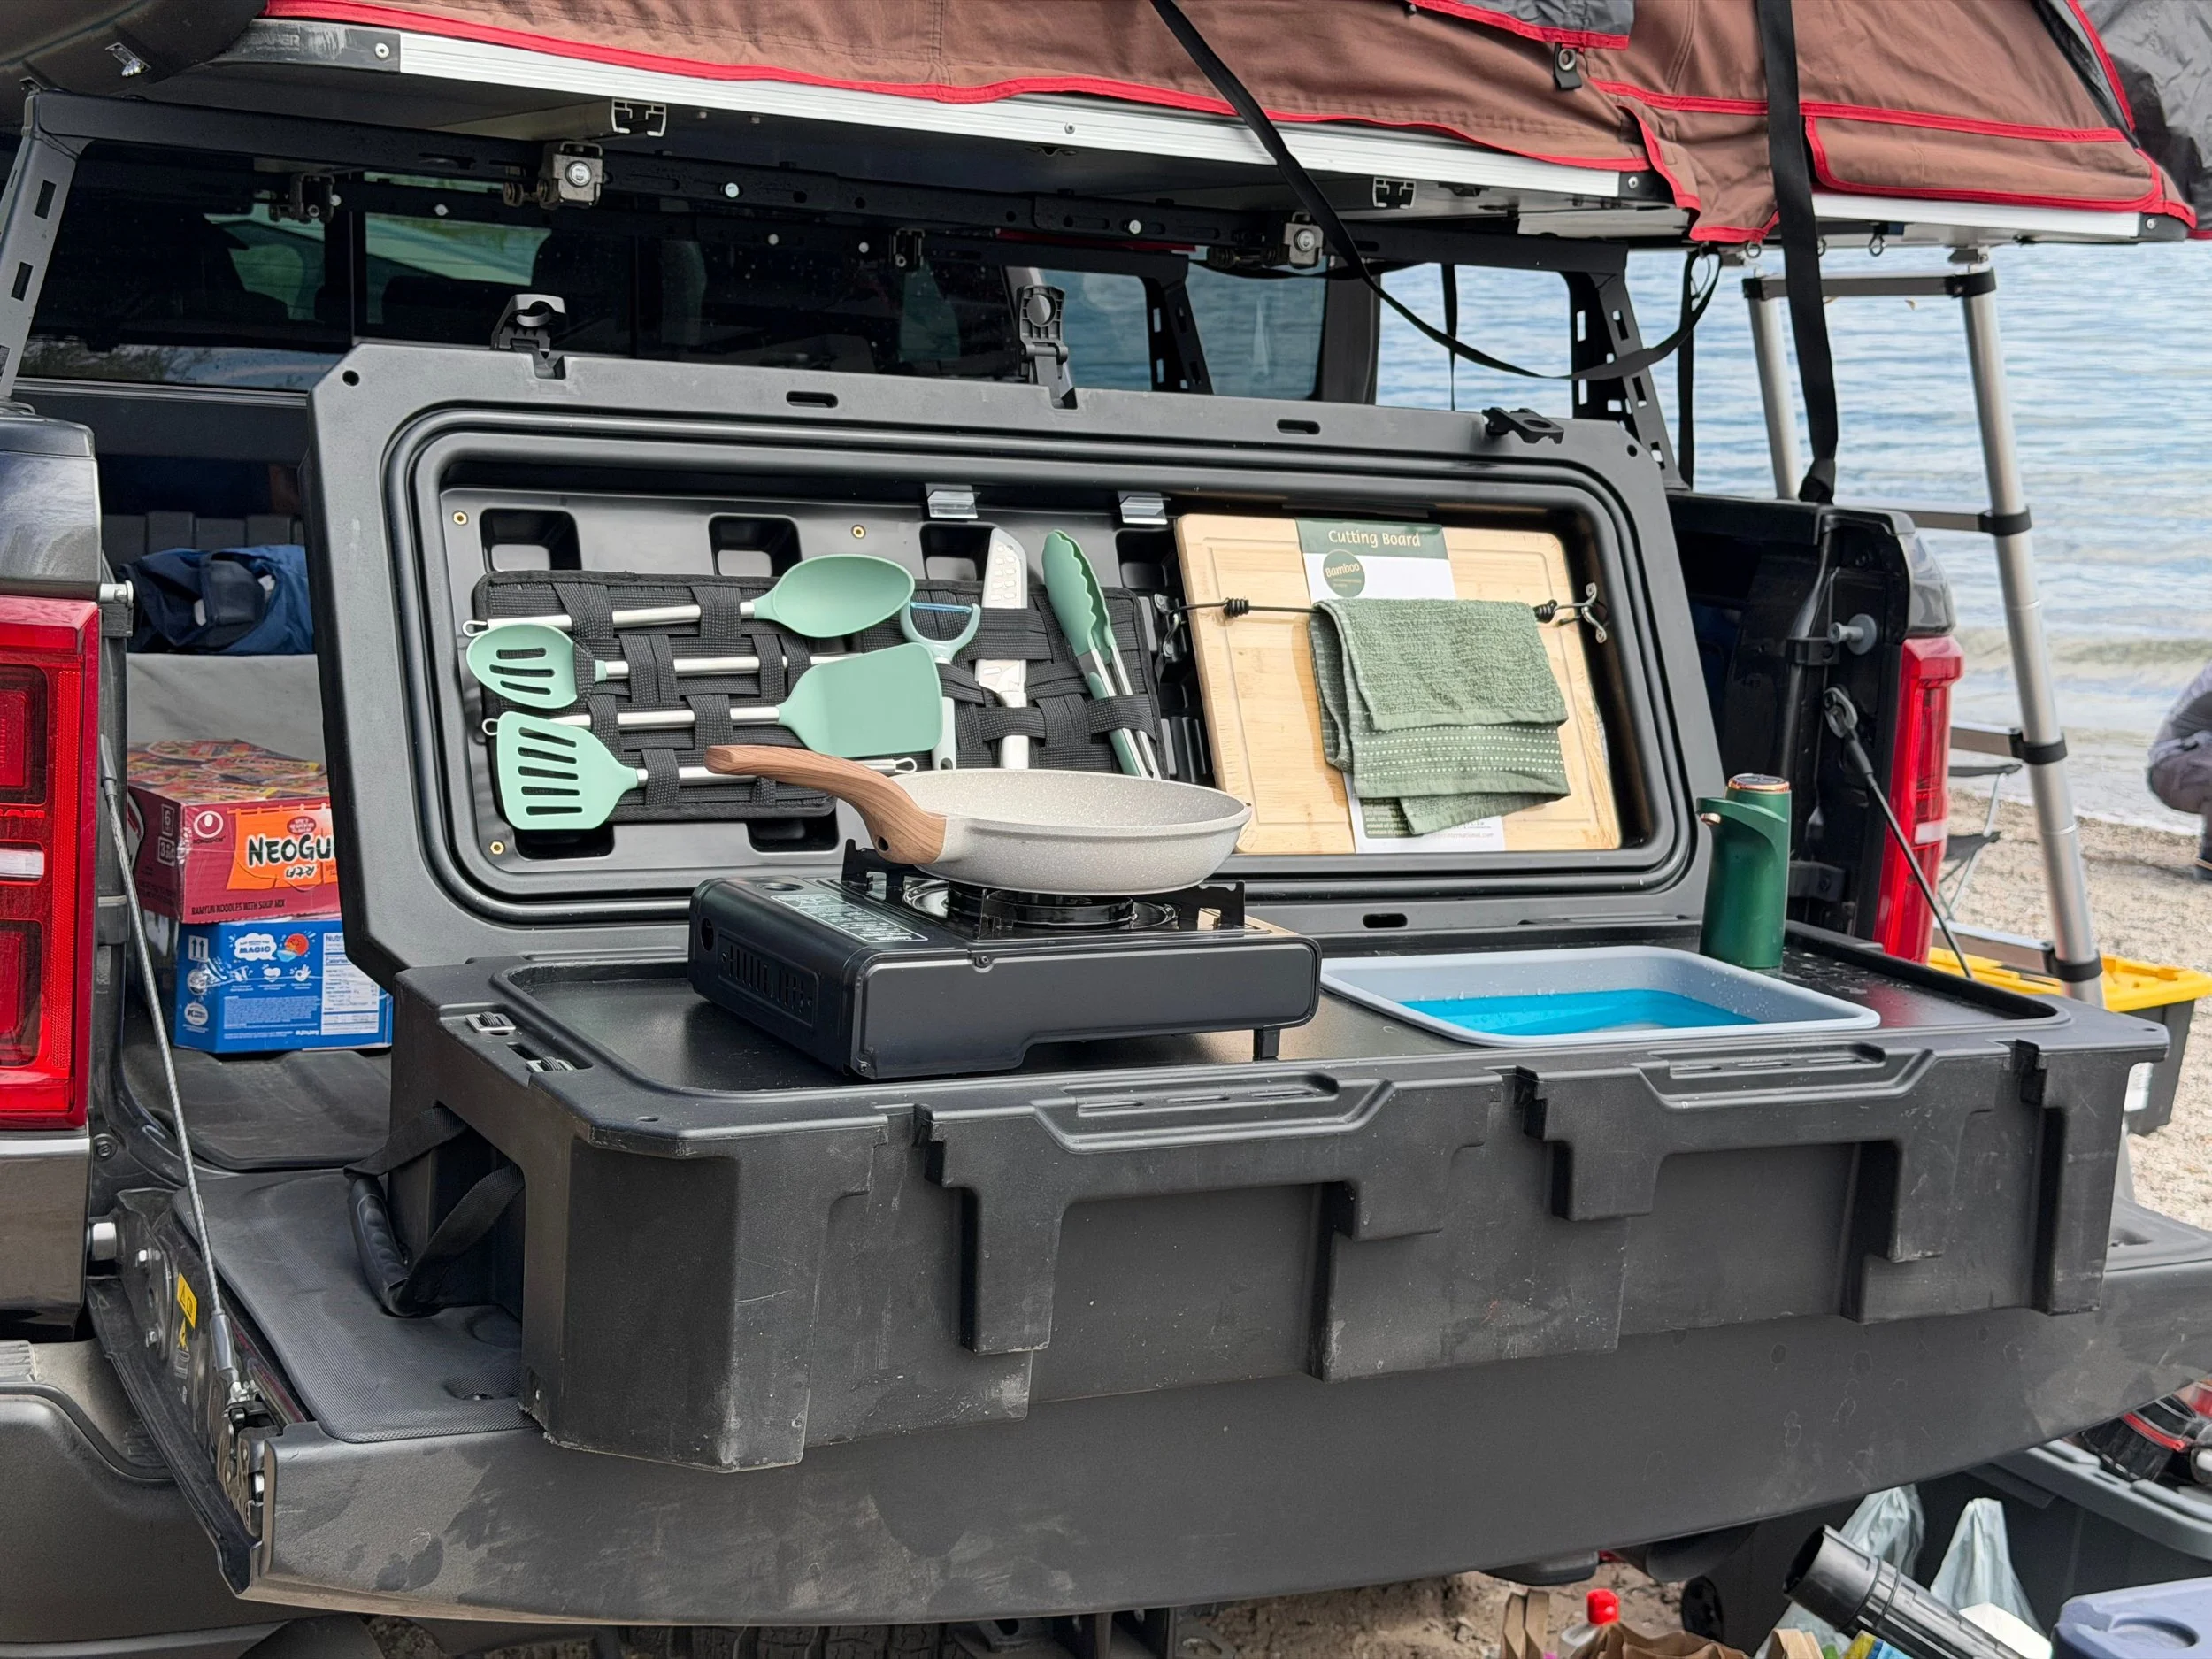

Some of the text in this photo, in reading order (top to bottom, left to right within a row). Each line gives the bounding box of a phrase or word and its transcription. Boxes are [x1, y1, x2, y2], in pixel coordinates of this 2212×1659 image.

[1328, 530, 1421, 548] Cutting Board
[1325, 563, 1360, 577] Bamboo
[248, 834, 334, 866] NEOGU
